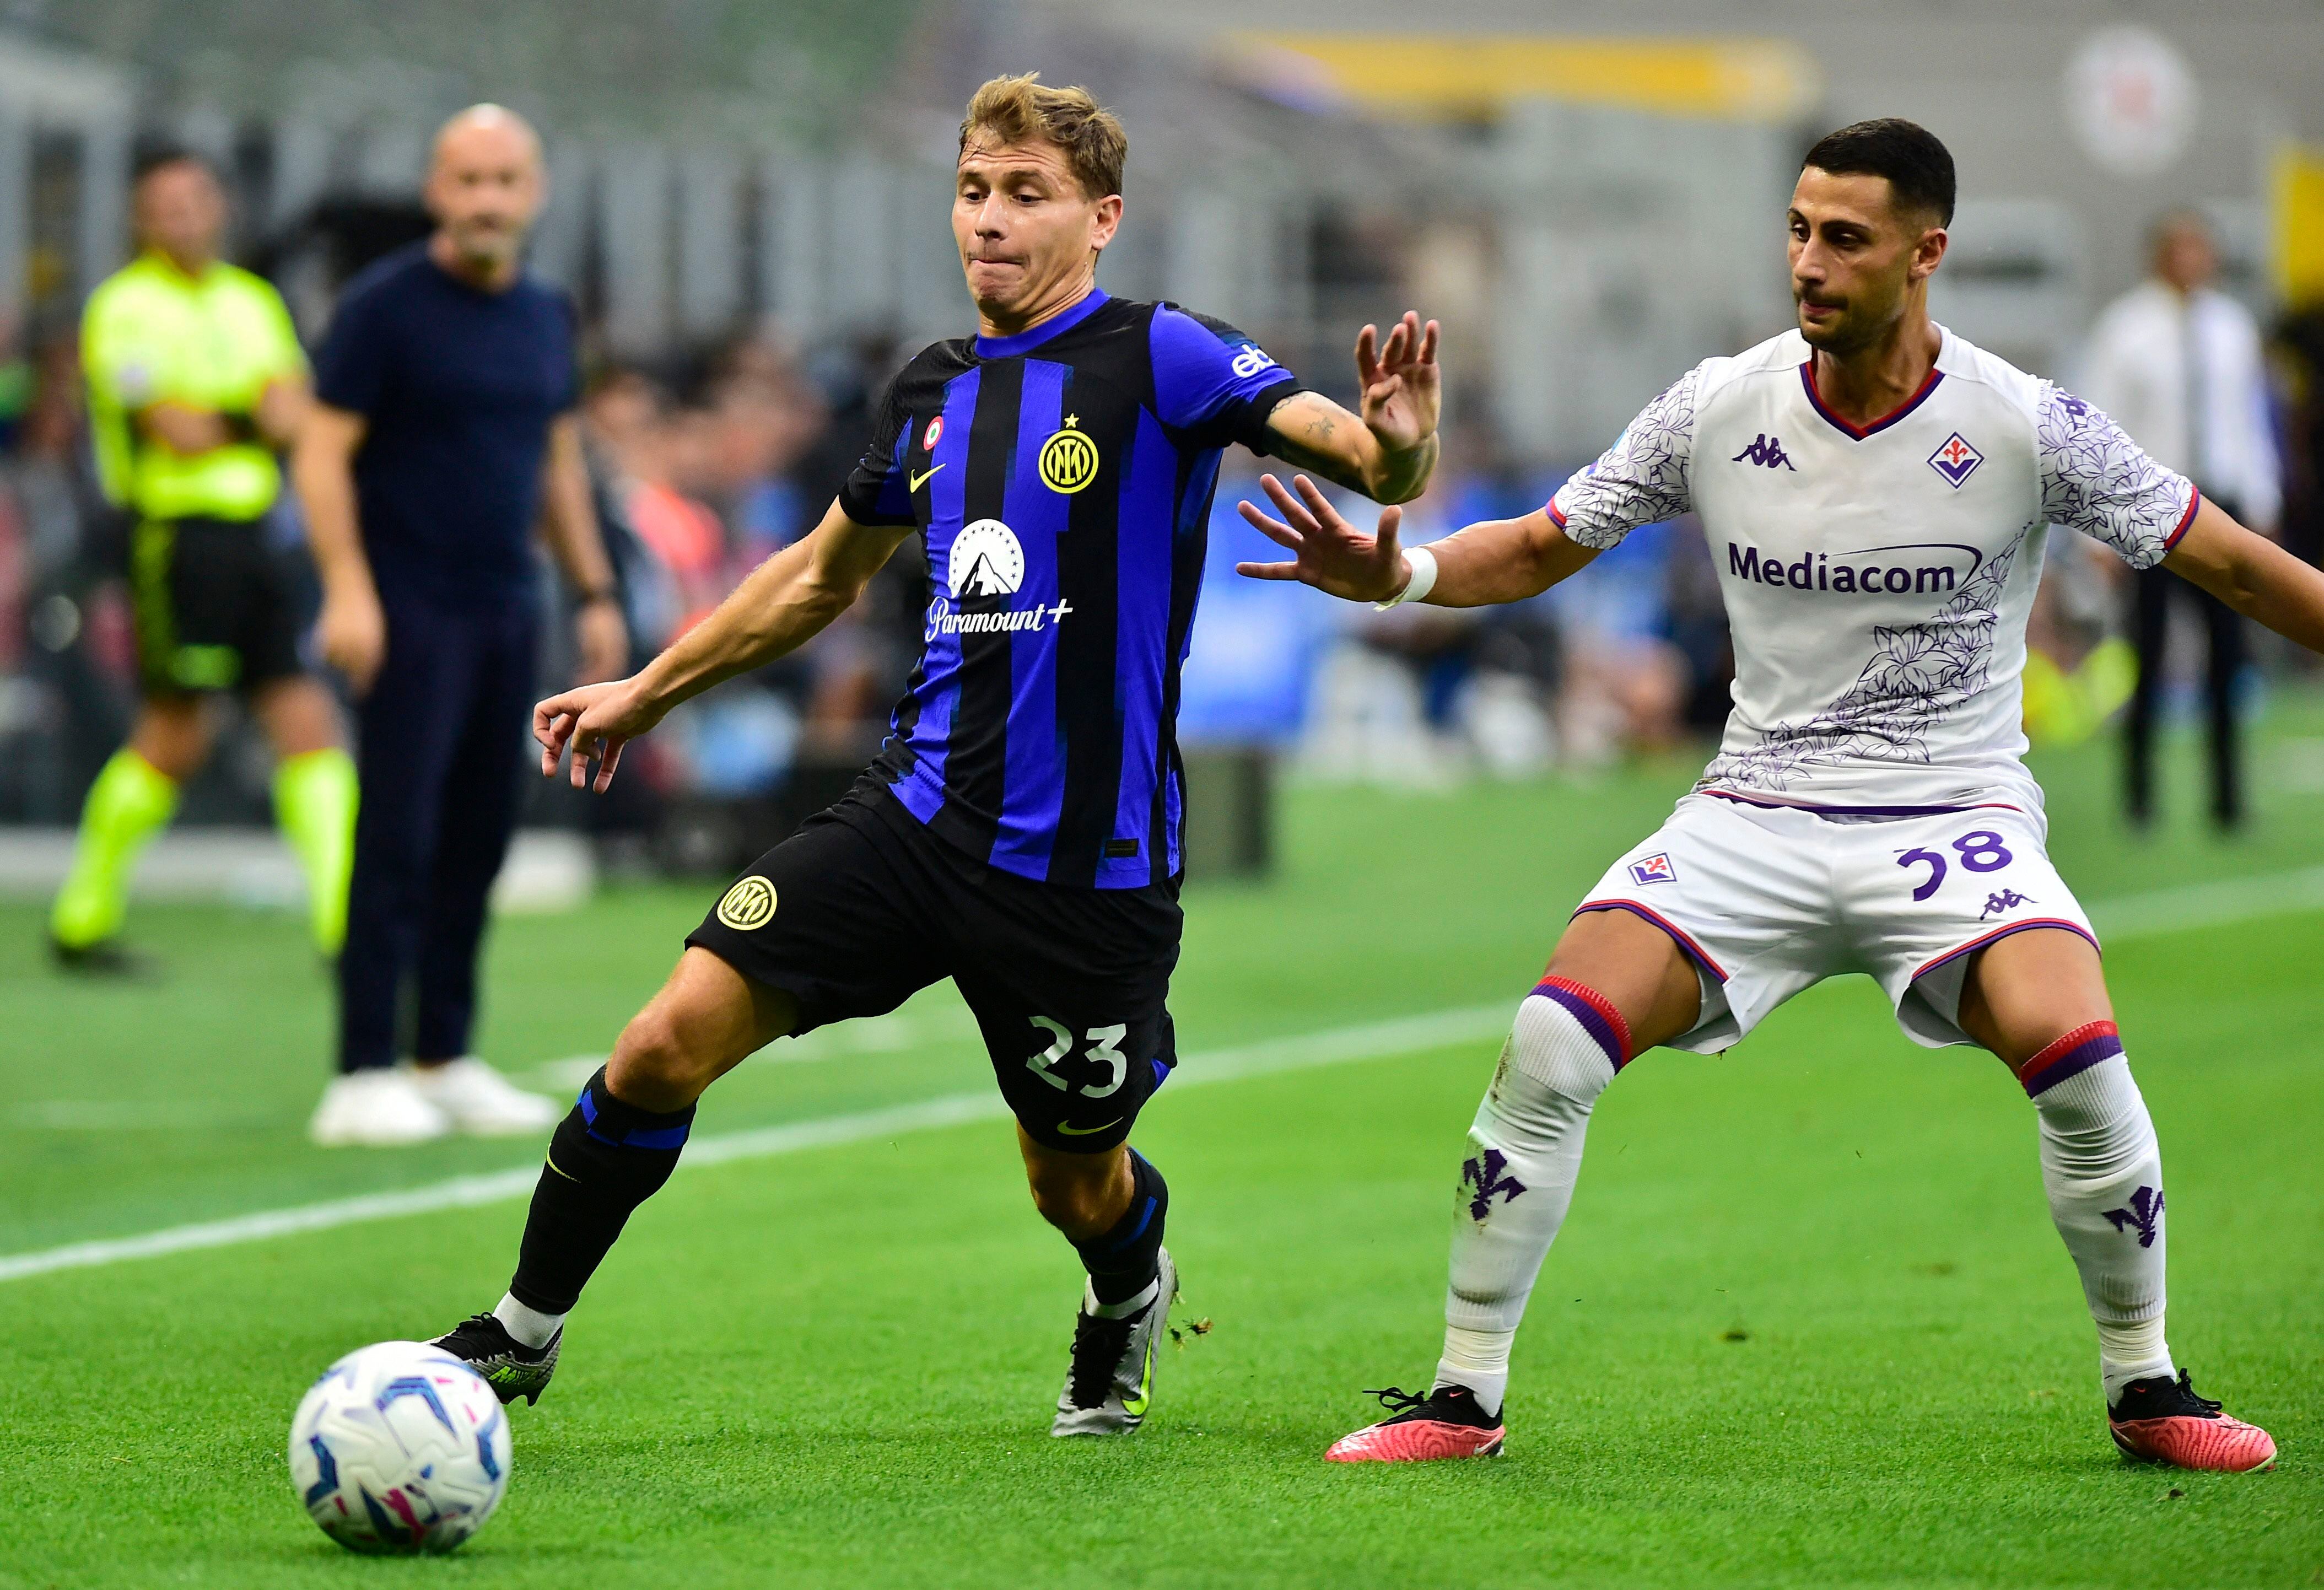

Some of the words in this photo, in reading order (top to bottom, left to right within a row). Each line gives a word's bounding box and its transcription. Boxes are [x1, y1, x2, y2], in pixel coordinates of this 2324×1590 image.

[1728, 542, 1955, 594] Mediacom
[924, 596, 1074, 642] Paramount+
[1894, 831, 2013, 902] 38
[1026, 1015, 1127, 1098] 23
